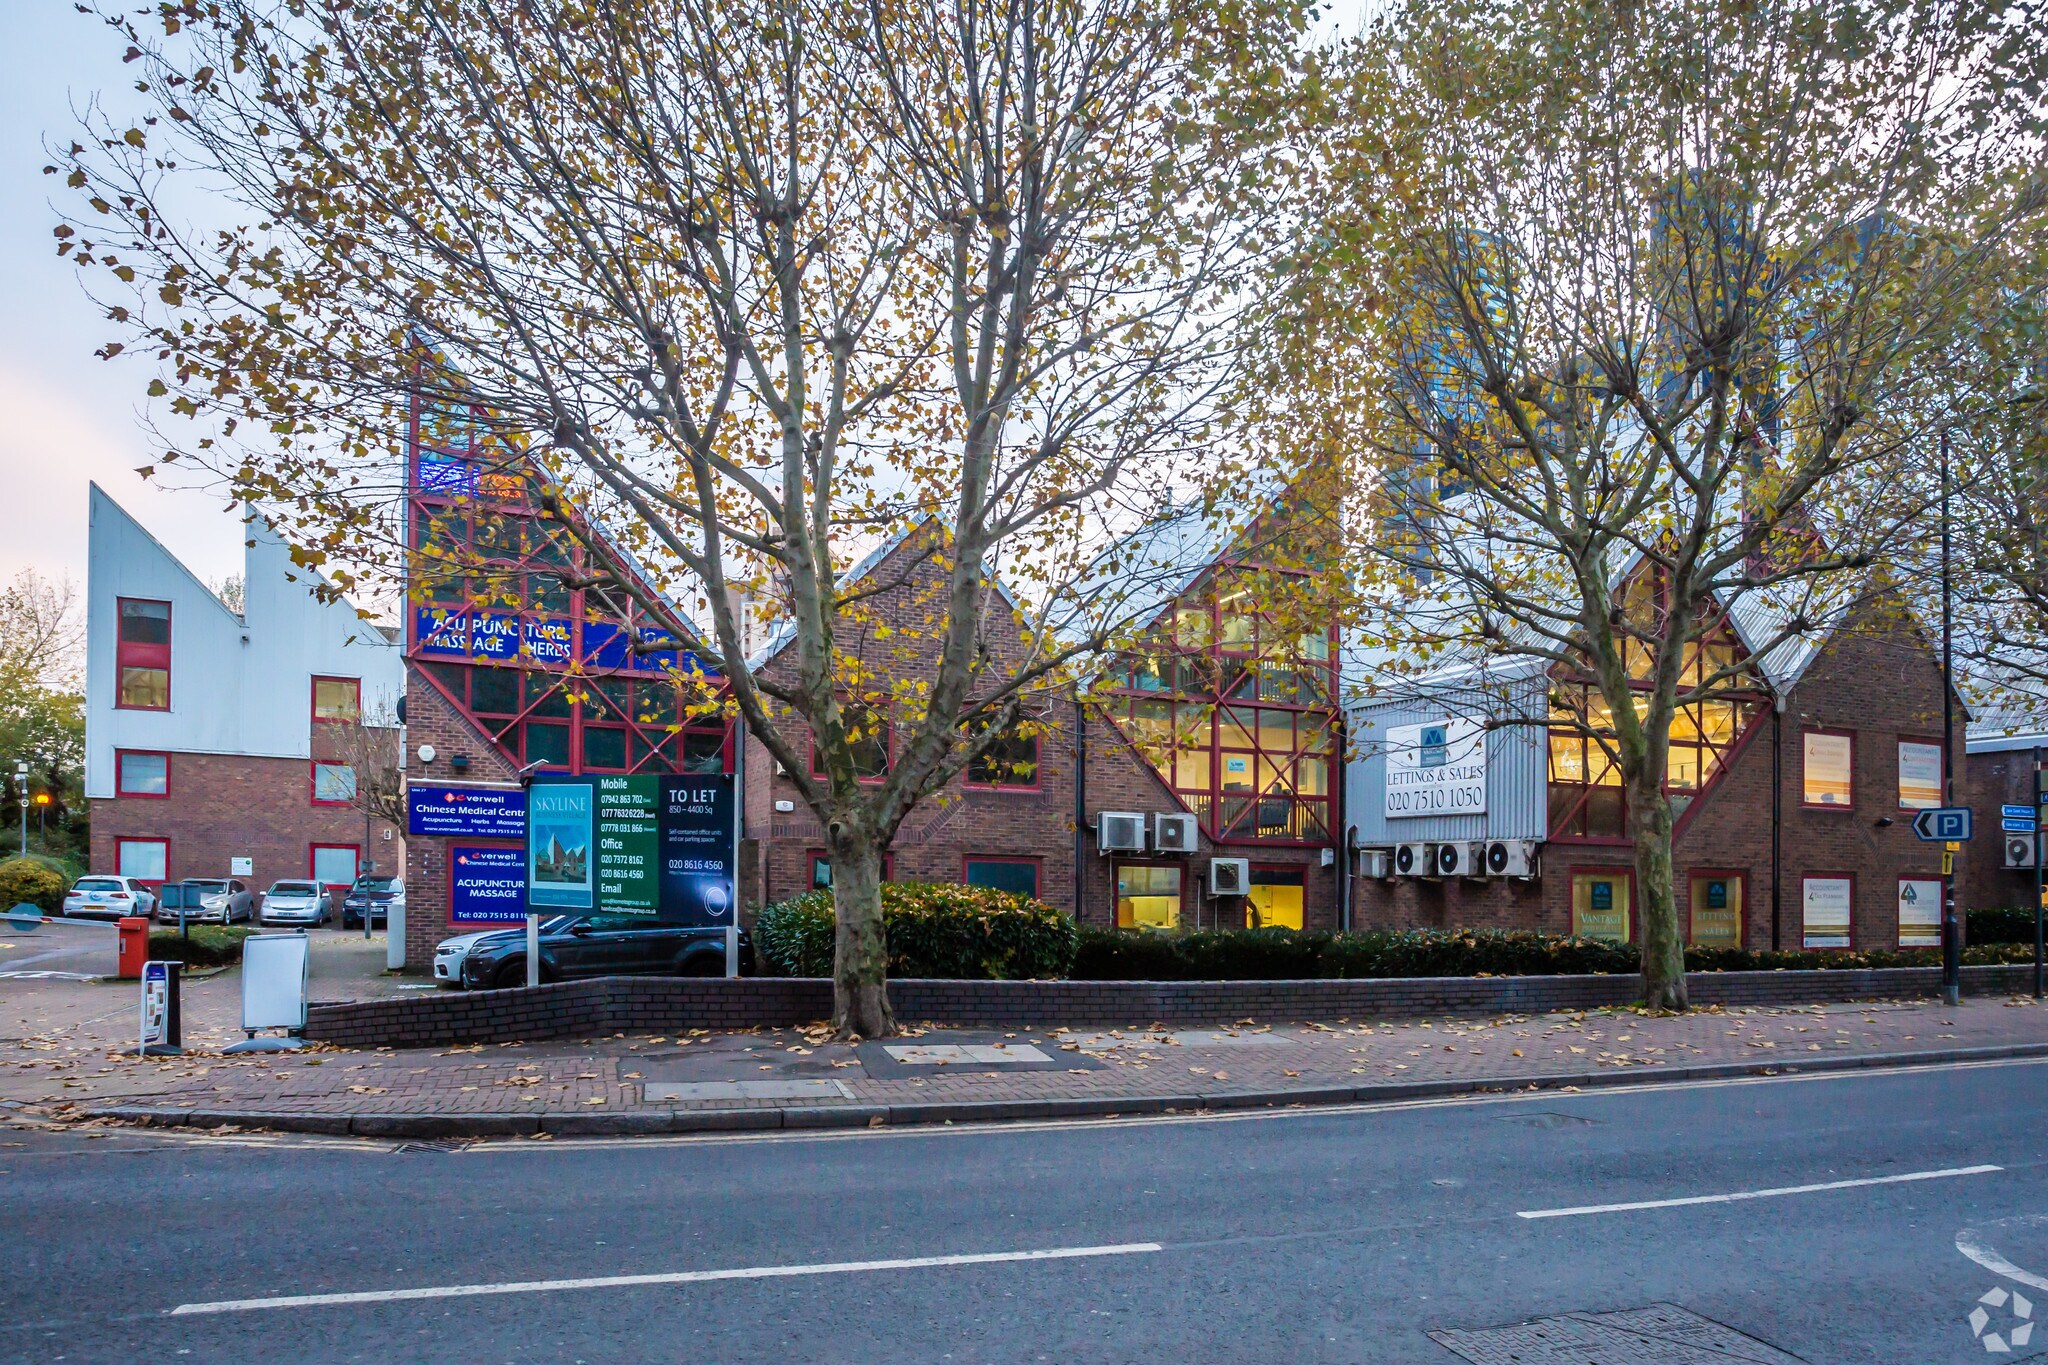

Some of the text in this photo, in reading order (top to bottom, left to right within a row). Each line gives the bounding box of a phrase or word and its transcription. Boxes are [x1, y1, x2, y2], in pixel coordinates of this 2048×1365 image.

[526, 641, 571, 658] HERBS
[1387, 765, 1485, 786] LETTINGS & SALES
[601, 778, 628, 789] Mobile
[456, 794, 505, 803] everwell
[669, 789, 717, 802] TO LET
[1387, 786, 1483, 811] 020 7510 1050
[536, 797, 587, 811] SKYLINE
[416, 804, 526, 817] Chinese Medical Centr
[669, 805, 681, 813] 850
[687, 805, 704, 813] 4400
[704, 805, 713, 815] Sq
[1943, 816, 1958, 835] P
[601, 838, 623, 849] Office
[472, 852, 517, 861] everwell
[601, 855, 644, 865] 020 7372 8162
[668, 859, 723, 870] 020 8616 4560
[601, 869, 644, 879] 020 8616 4560
[457, 878, 525, 888] ACUPUNCTUR
[601, 883, 622, 893] Email
[469, 889, 518, 898] MASSAGE
[472, 911, 488, 919] 020
[1580, 912, 1621, 924] VANTAGE
